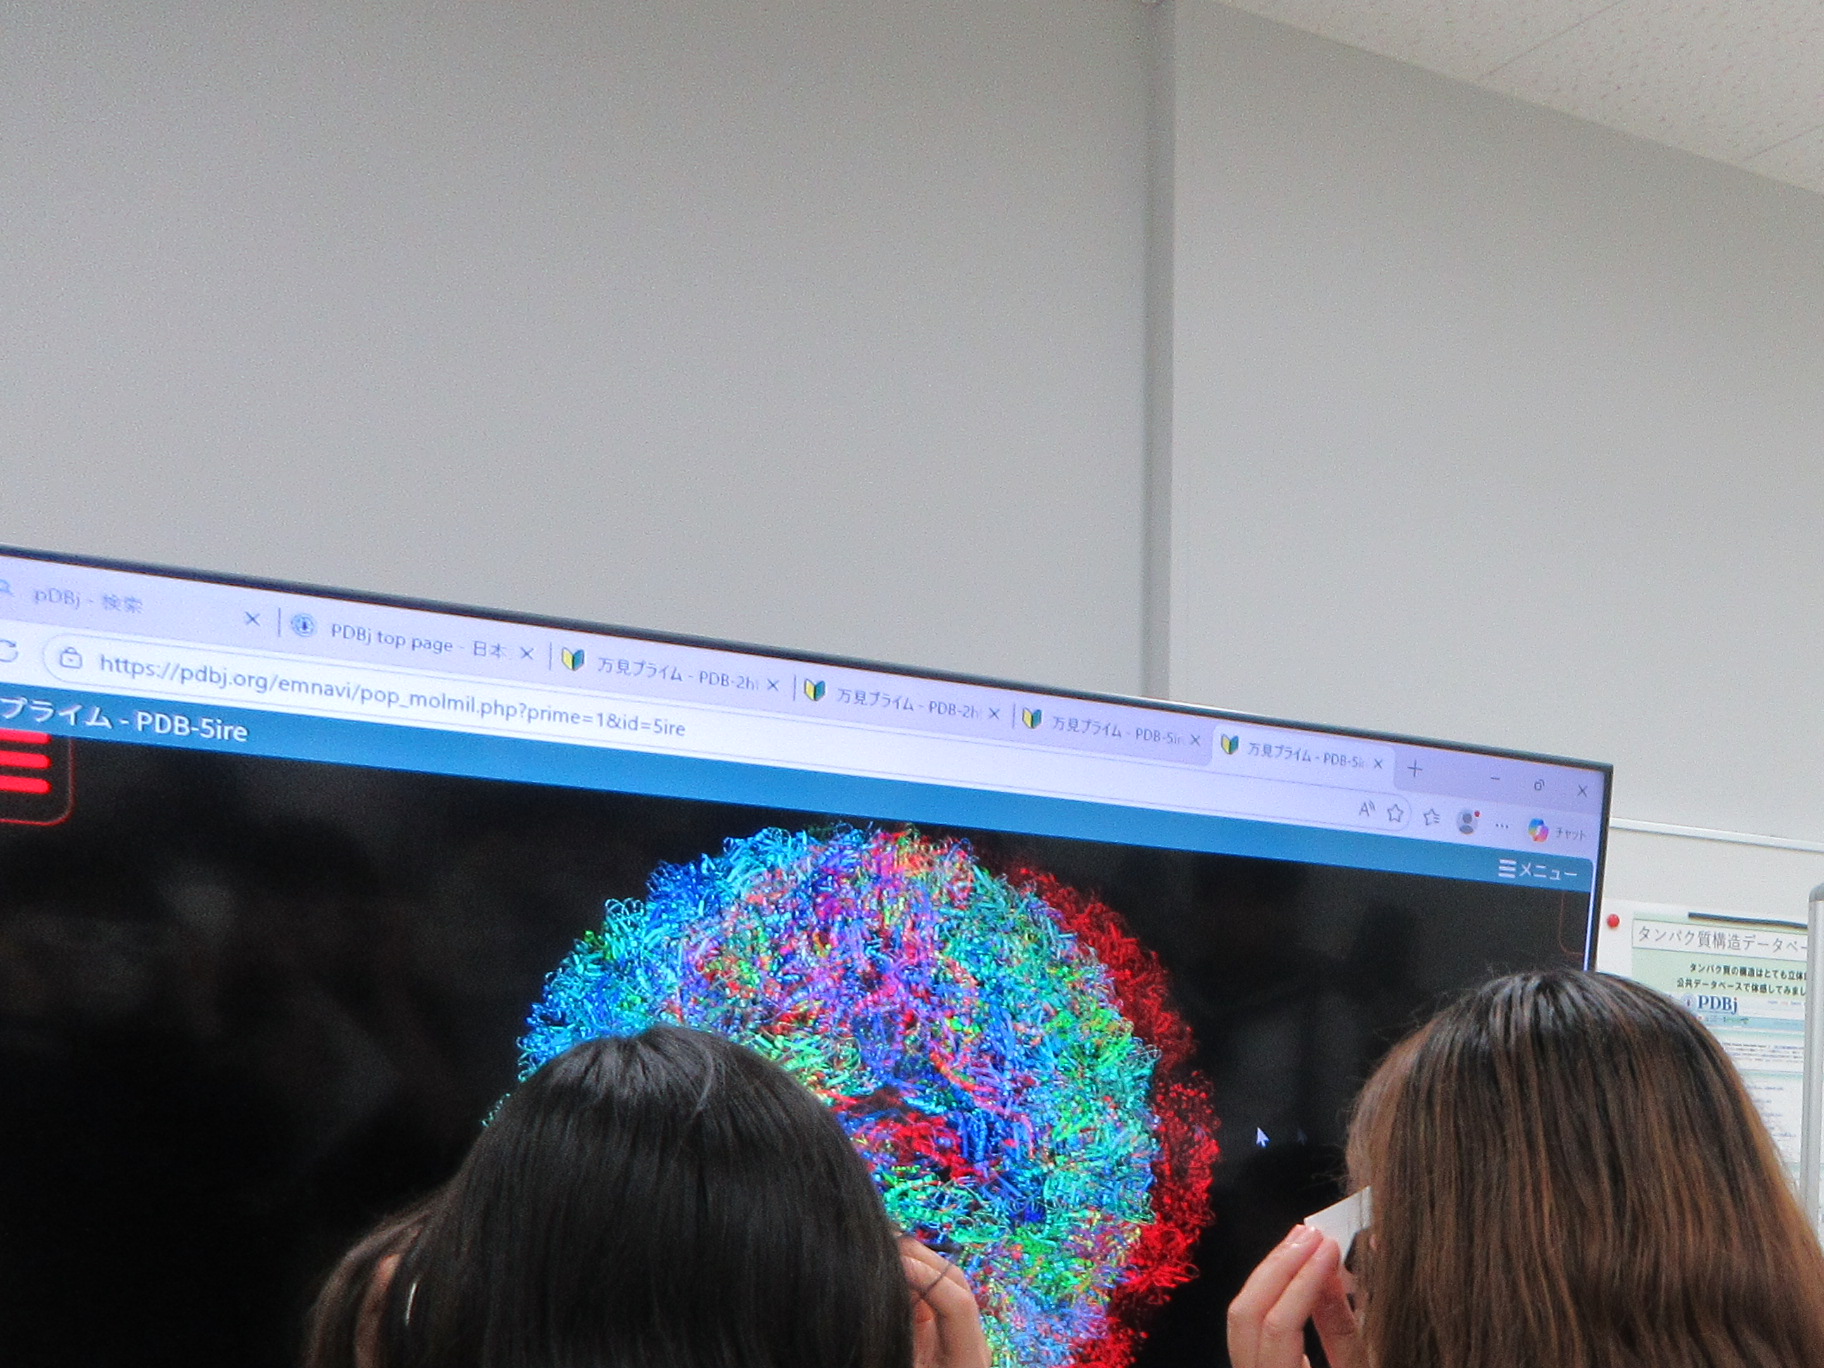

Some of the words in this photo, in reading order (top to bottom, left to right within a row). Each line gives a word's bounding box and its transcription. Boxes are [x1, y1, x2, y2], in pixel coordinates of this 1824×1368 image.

[331, 622, 372, 645] PDBj
[376, 628, 406, 649] top
[411, 635, 453, 656] page
[598, 656, 684, 682] 万見プライム
[699, 670, 759, 692] PDB-2h
[100, 654, 687, 738] https://pdbj.org/emnavi/pop_molmil.php?prime=1&id=5ire
[838, 687, 914, 713] 万見プライム
[0, 696, 113, 730] プライム
[136, 710, 250, 743] PDB-5ire
[1053, 715, 1123, 739] 万見プライム
[1248, 741, 1312, 763] 万見プライム
[1519, 862, 1579, 881] メニュー
[1638, 925, 1808, 954] タンパク質構造データベー
[1697, 994, 1738, 1014] PDBj
